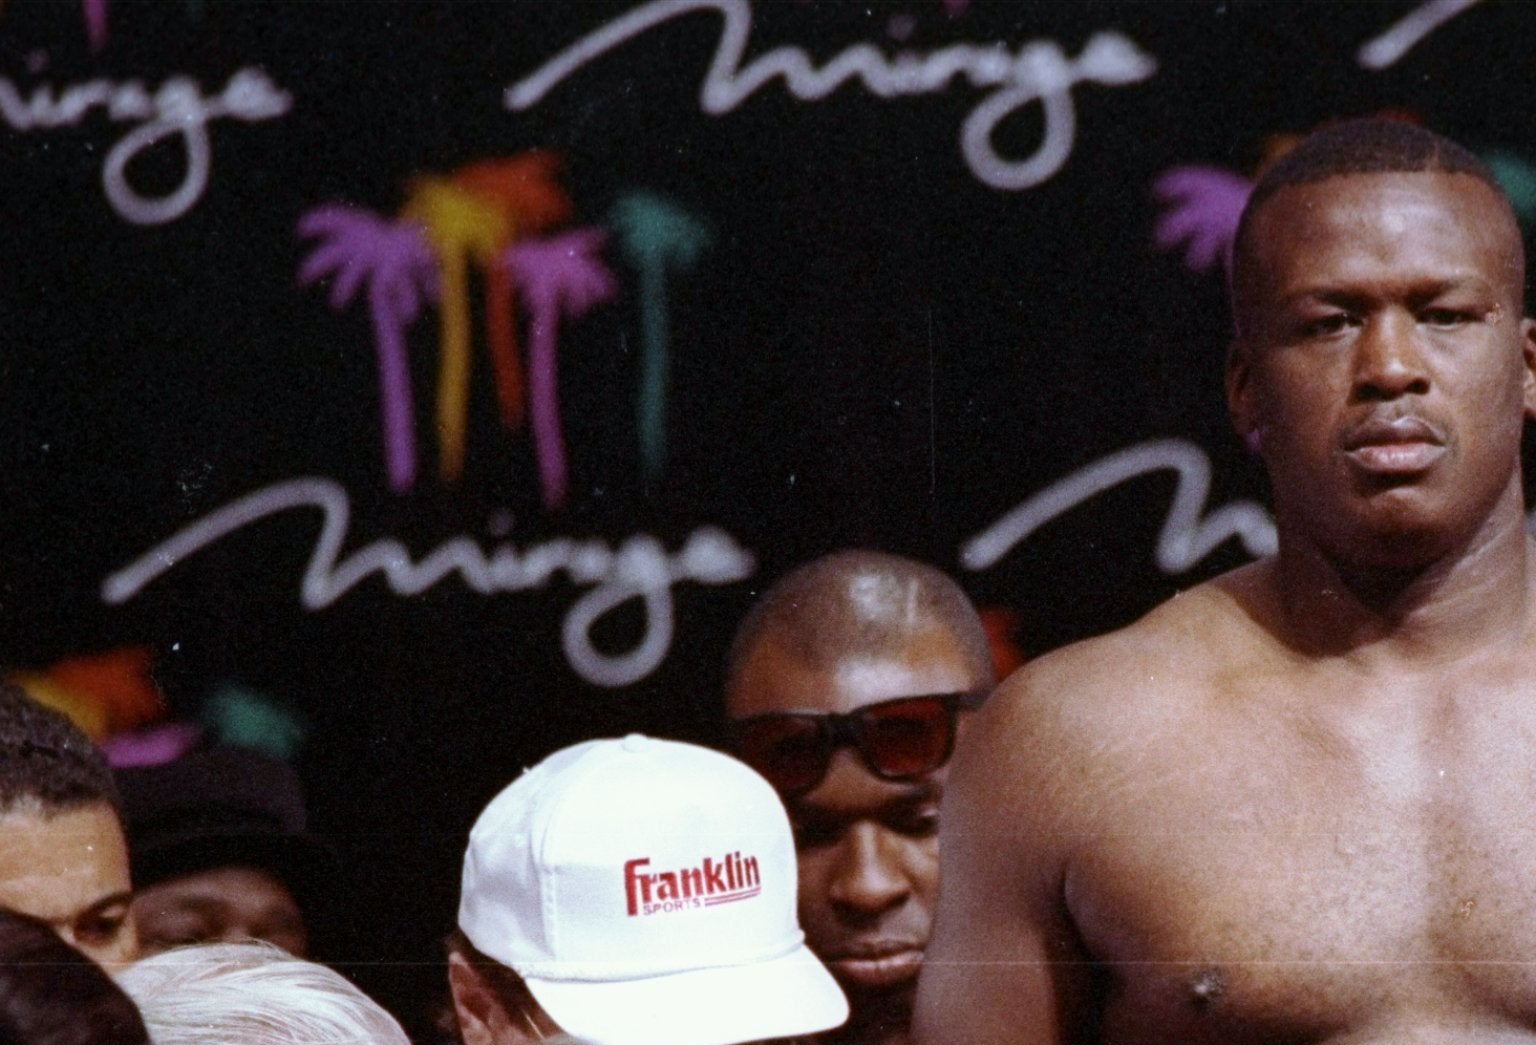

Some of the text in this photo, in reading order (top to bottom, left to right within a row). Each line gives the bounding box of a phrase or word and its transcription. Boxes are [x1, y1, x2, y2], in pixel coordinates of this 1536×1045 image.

[0, 50, 292, 226] irage
[504, 0, 1158, 190] Mirage
[102, 476, 756, 688] Mirage
[624, 851, 761, 917] Franklin
[643, 897, 701, 916] SPORTS
